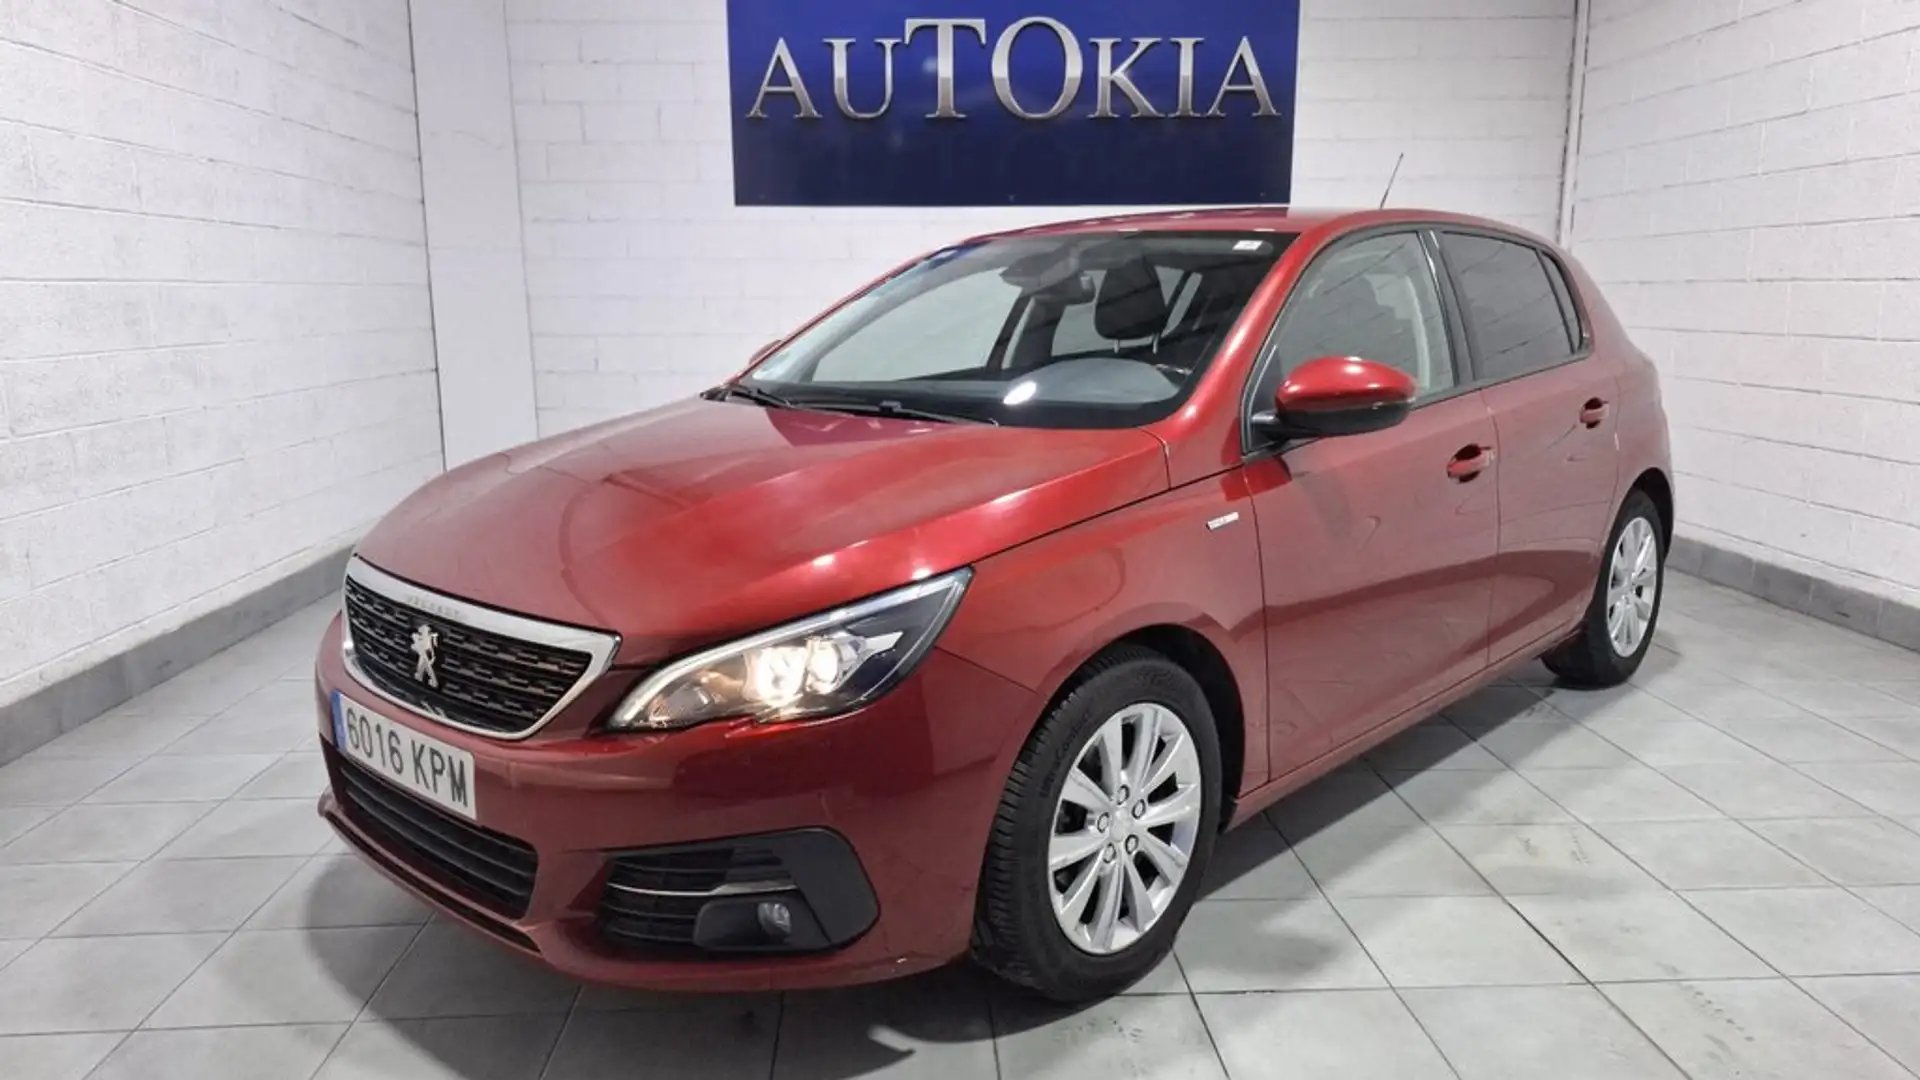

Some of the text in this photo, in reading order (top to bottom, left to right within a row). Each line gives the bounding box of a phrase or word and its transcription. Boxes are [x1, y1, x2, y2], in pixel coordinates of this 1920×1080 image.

[746, 16, 1282, 119] AUTOKIA
[346, 708, 468, 808] 6016 KPM
